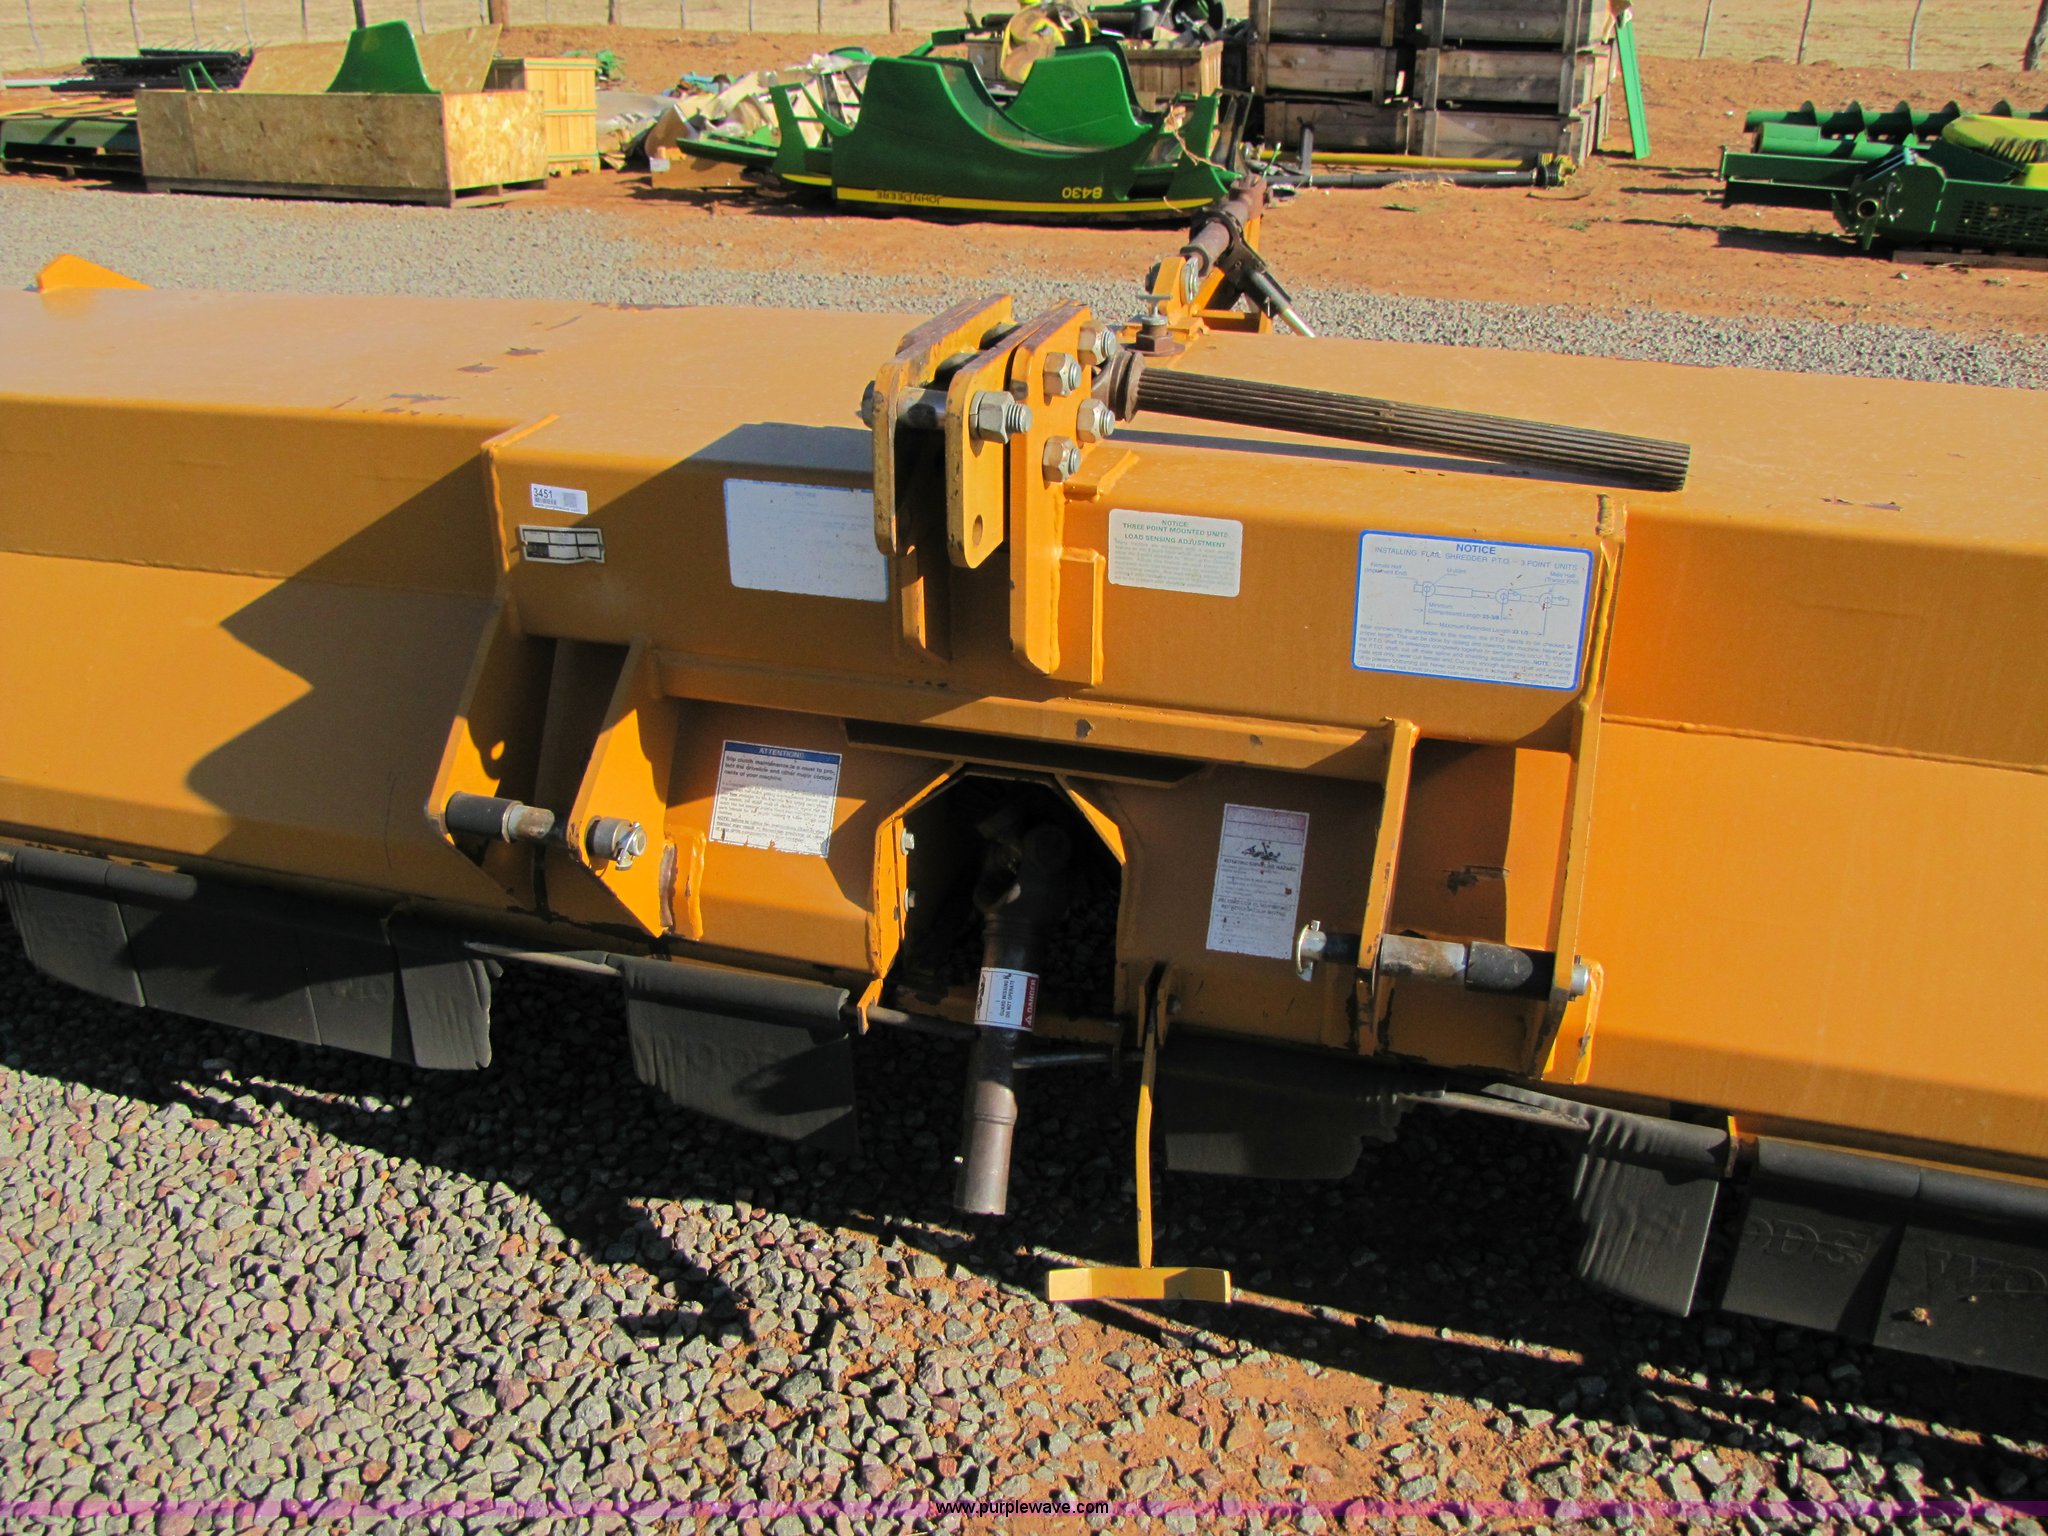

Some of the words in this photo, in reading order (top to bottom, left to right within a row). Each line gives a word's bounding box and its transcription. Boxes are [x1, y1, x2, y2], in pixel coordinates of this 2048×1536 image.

[1062, 187, 1103, 199] 8430
[533, 487, 553, 499] 3451
[1169, 527, 1205, 536] MOUNTED
[1146, 535, 1176, 543] SENSING
[1178, 538, 1226, 548] ADJUSTMENT
[1456, 543, 1496, 555] NOTICE
[1375, 546, 1417, 556] INSTALLING
[1445, 552, 1488, 563] SHREDDER
[1527, 560, 1551, 569] POINT
[1554, 563, 1578, 571] UNITS
[737, 757, 753, 765] clutch
[1026, 979, 1037, 1014] DANGER
